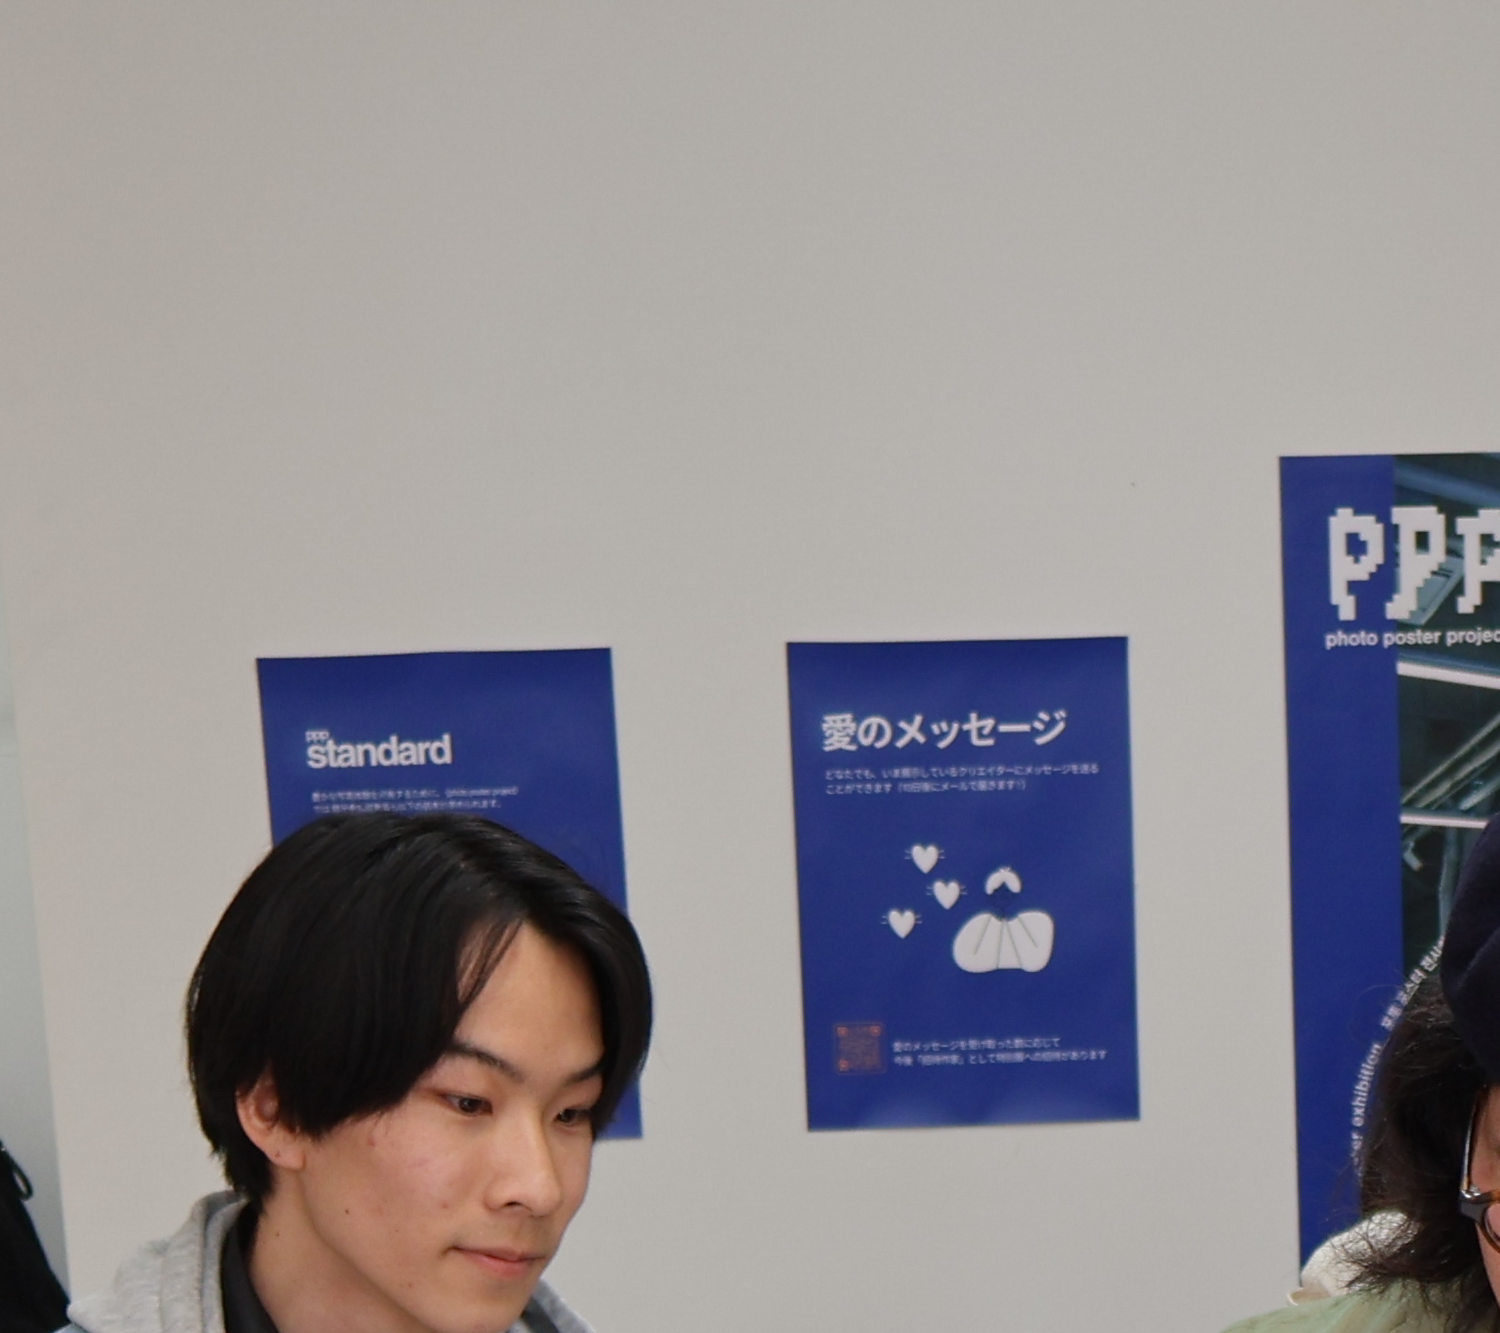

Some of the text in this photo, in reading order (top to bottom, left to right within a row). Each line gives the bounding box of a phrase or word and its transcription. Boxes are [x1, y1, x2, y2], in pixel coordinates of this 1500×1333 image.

[1325, 630, 1378, 650] photo
[1383, 629, 1442, 648] poster
[822, 709, 1068, 751] 愛のメッセージ
[306, 732, 453, 769] standard
